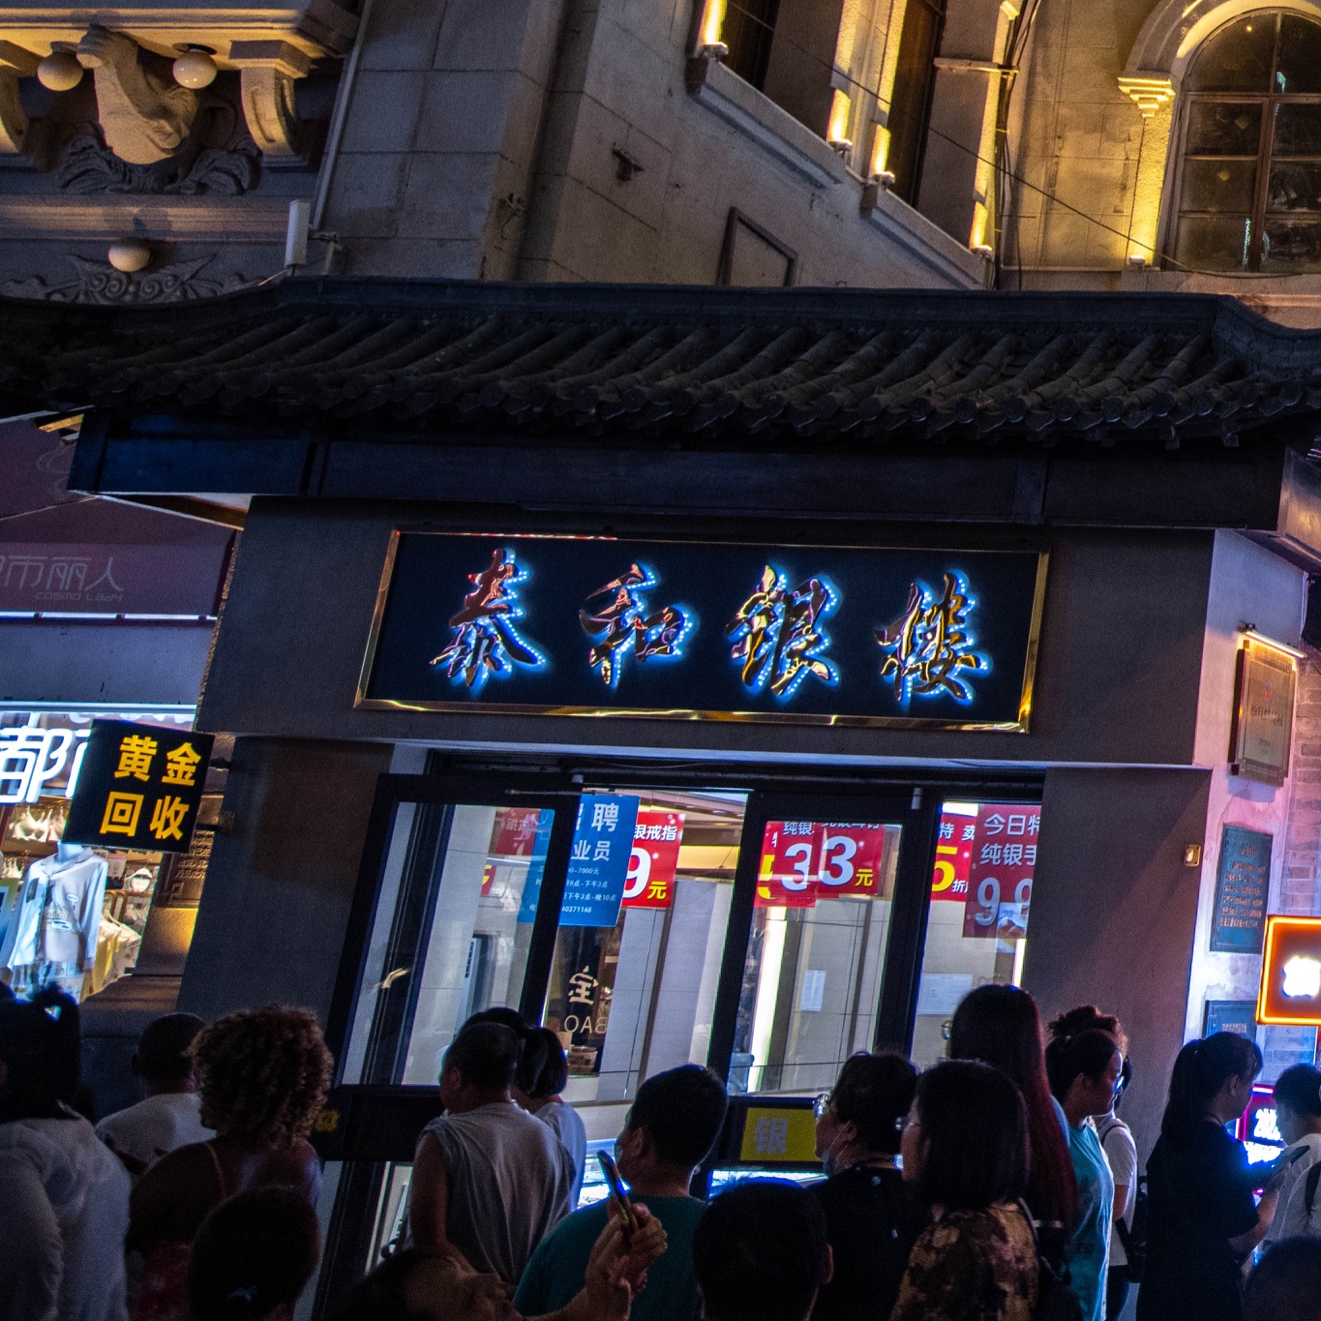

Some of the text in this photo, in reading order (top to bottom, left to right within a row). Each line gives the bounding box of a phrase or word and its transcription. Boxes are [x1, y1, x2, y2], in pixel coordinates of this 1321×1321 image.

[0, 555, 124, 592] 市丽人
[114, 734, 202, 786] 黄金
[99, 785, 191, 840] 回收
[576, 803, 619, 832] 聘
